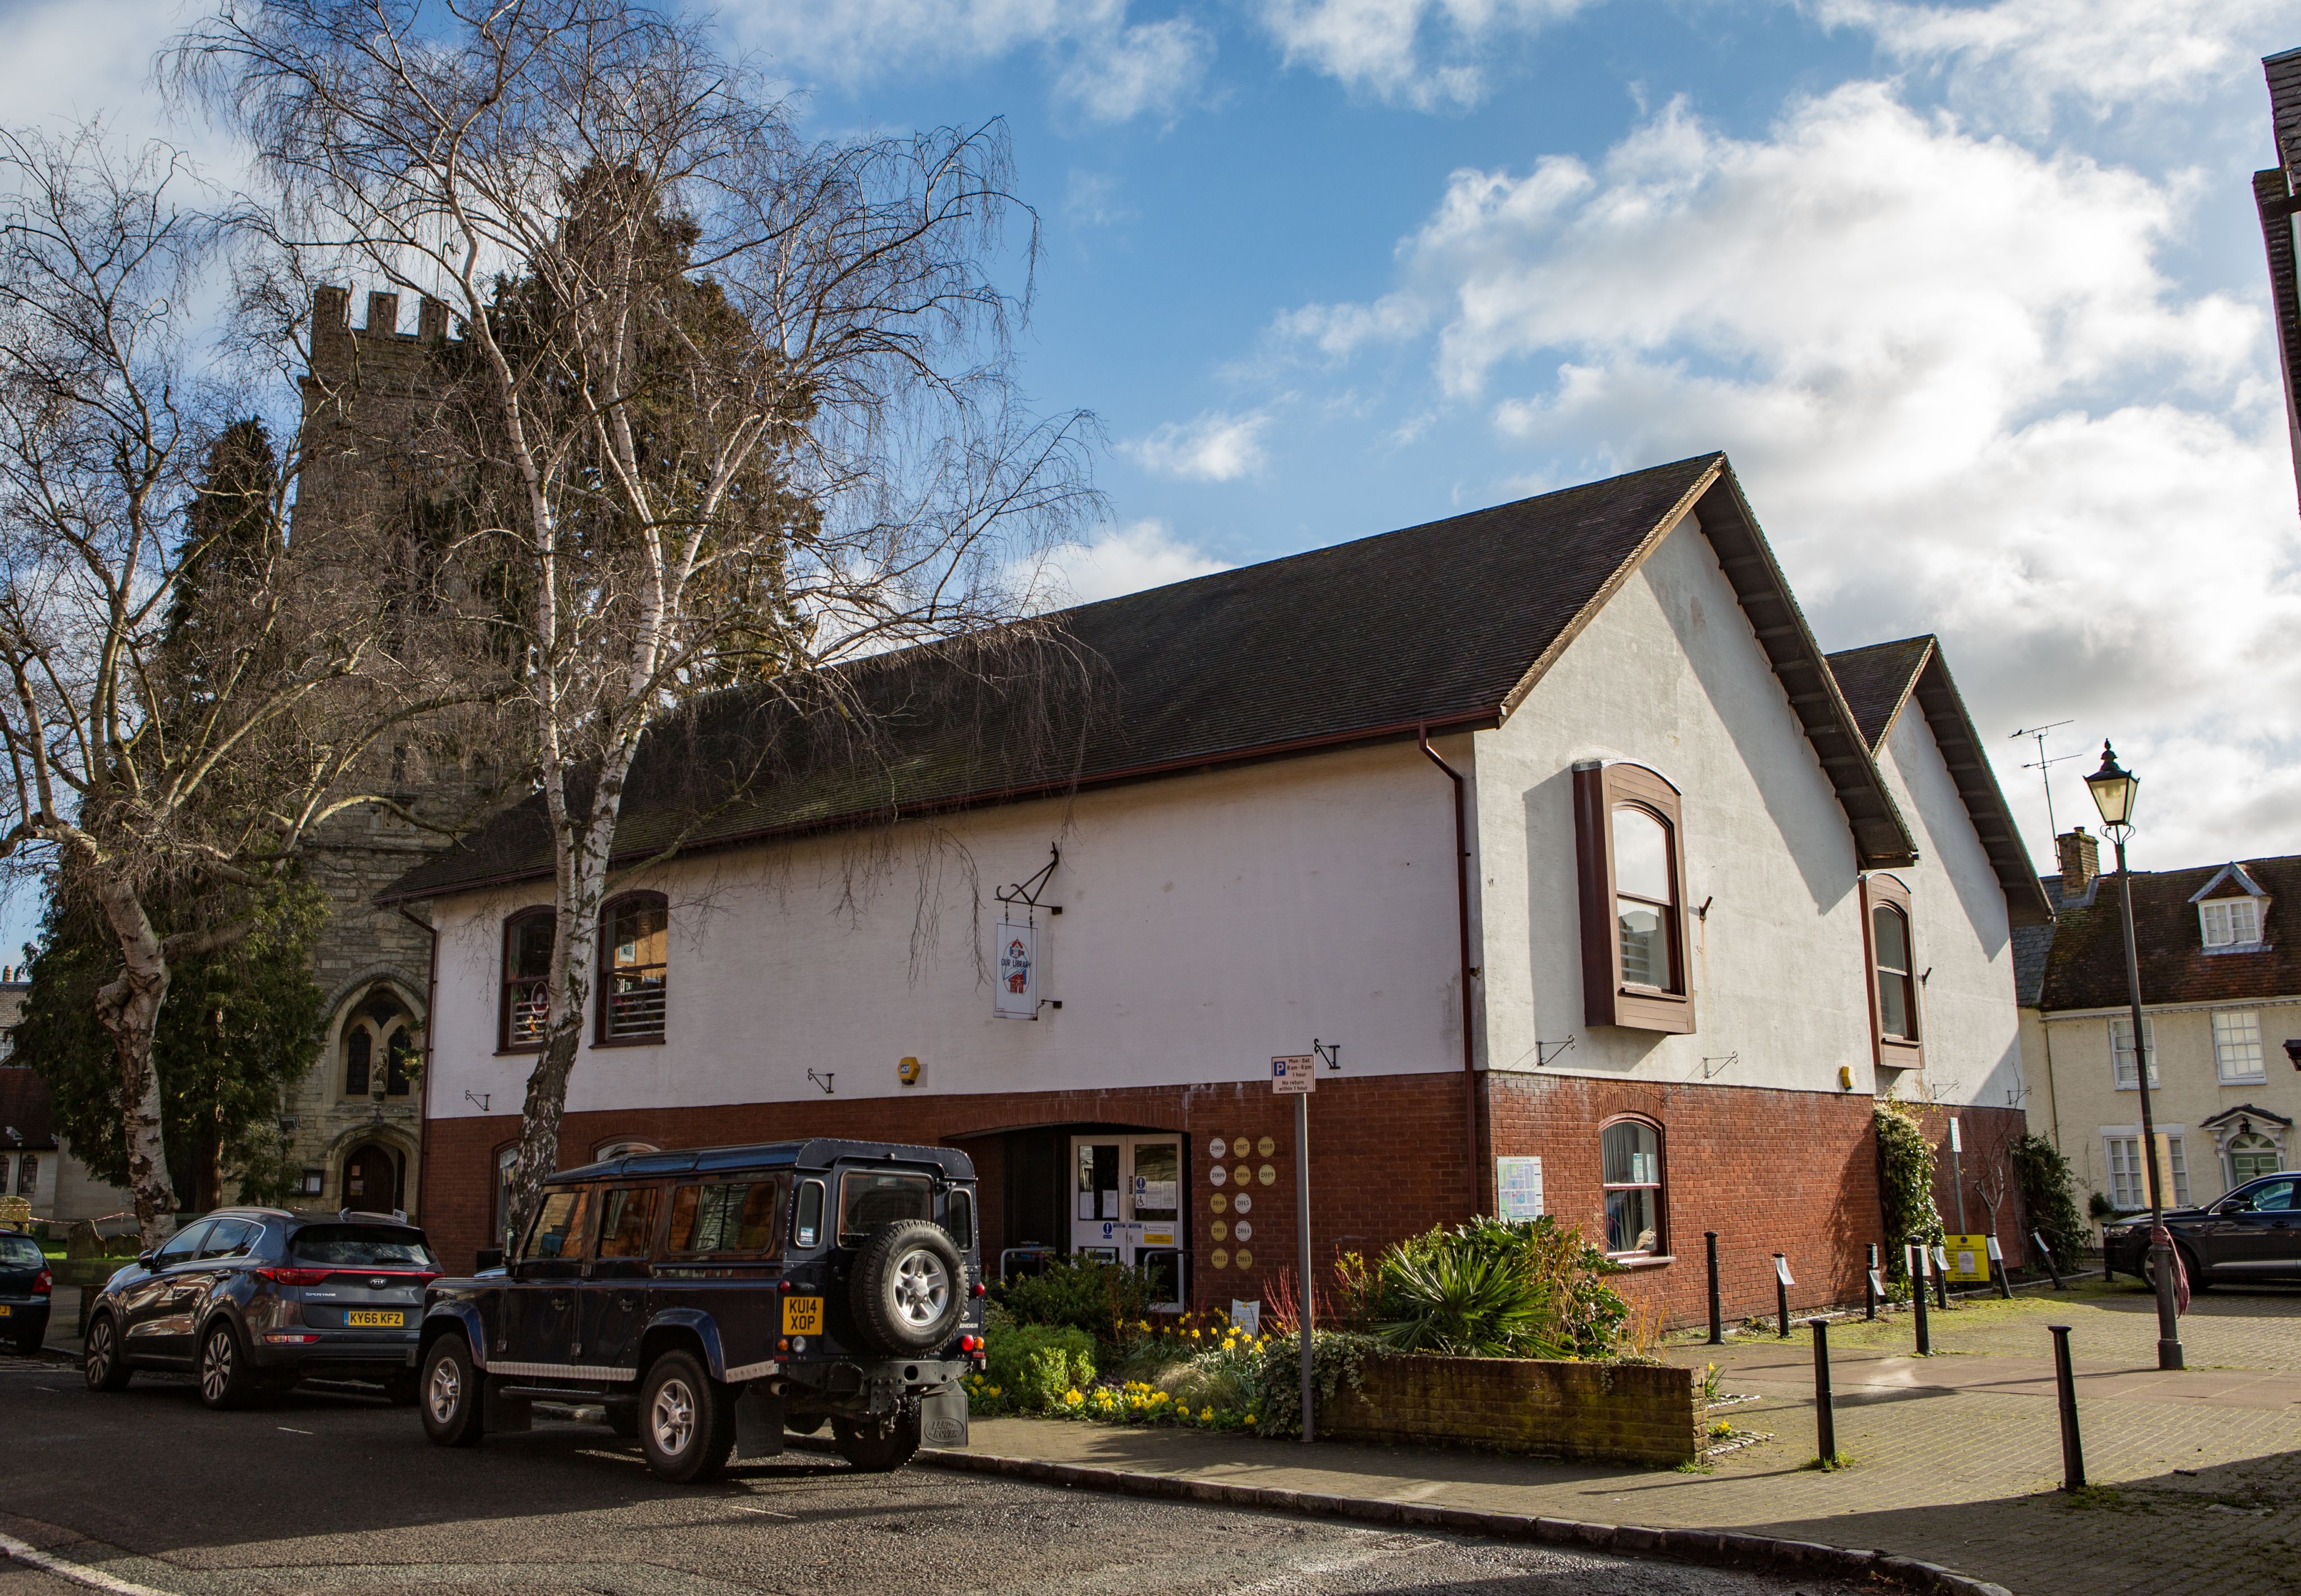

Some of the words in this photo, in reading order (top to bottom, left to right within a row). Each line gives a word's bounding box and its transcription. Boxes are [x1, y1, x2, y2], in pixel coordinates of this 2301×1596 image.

[1277, 1063, 1284, 1075] P
[789, 1299, 817, 1313] KU14
[350, 1312, 378, 1324] KY66
[381, 1313, 401, 1324] KFZ
[791, 1316, 816, 1330] XOP
[931, 1420, 952, 1430] LAND
[933, 1429, 959, 1439] ROVER
